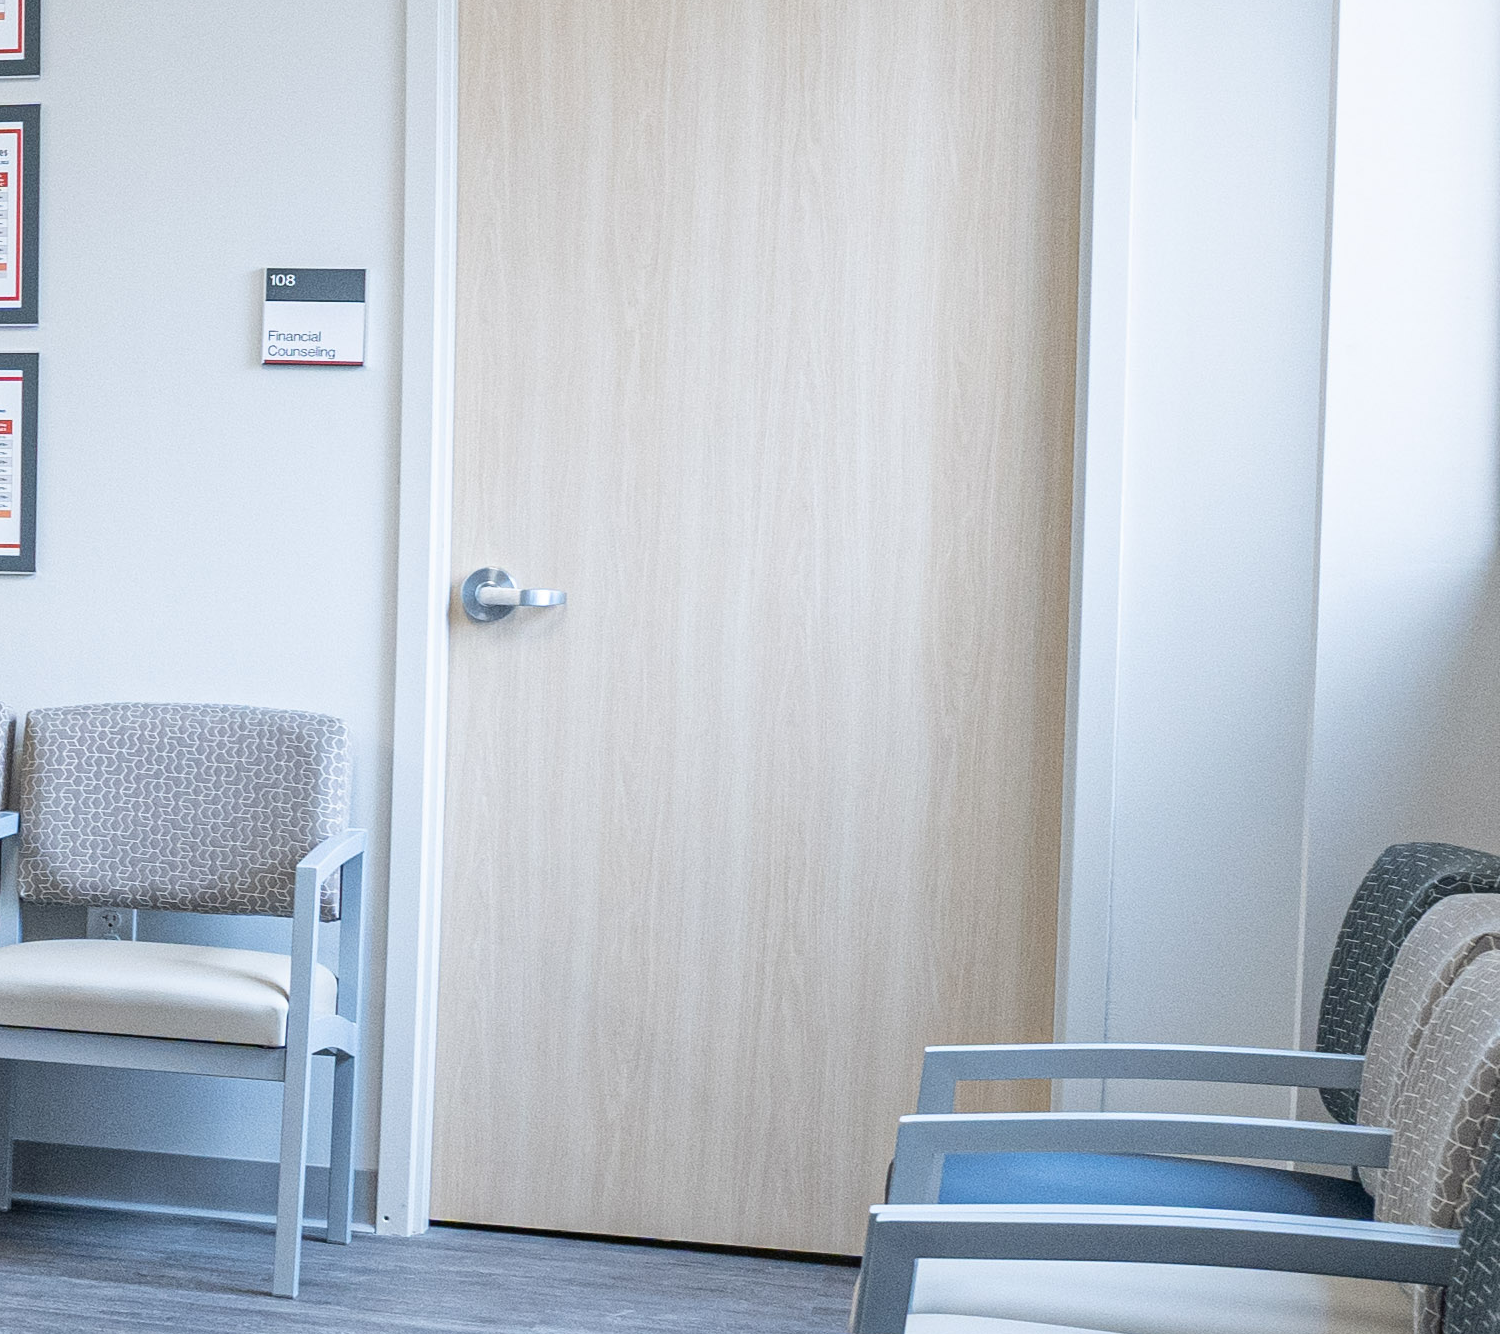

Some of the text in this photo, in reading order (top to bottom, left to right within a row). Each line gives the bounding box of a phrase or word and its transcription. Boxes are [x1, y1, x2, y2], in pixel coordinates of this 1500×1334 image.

[270, 274, 296, 287] 108
[268, 330, 322, 342] Financial
[268, 345, 336, 359] Counseling
